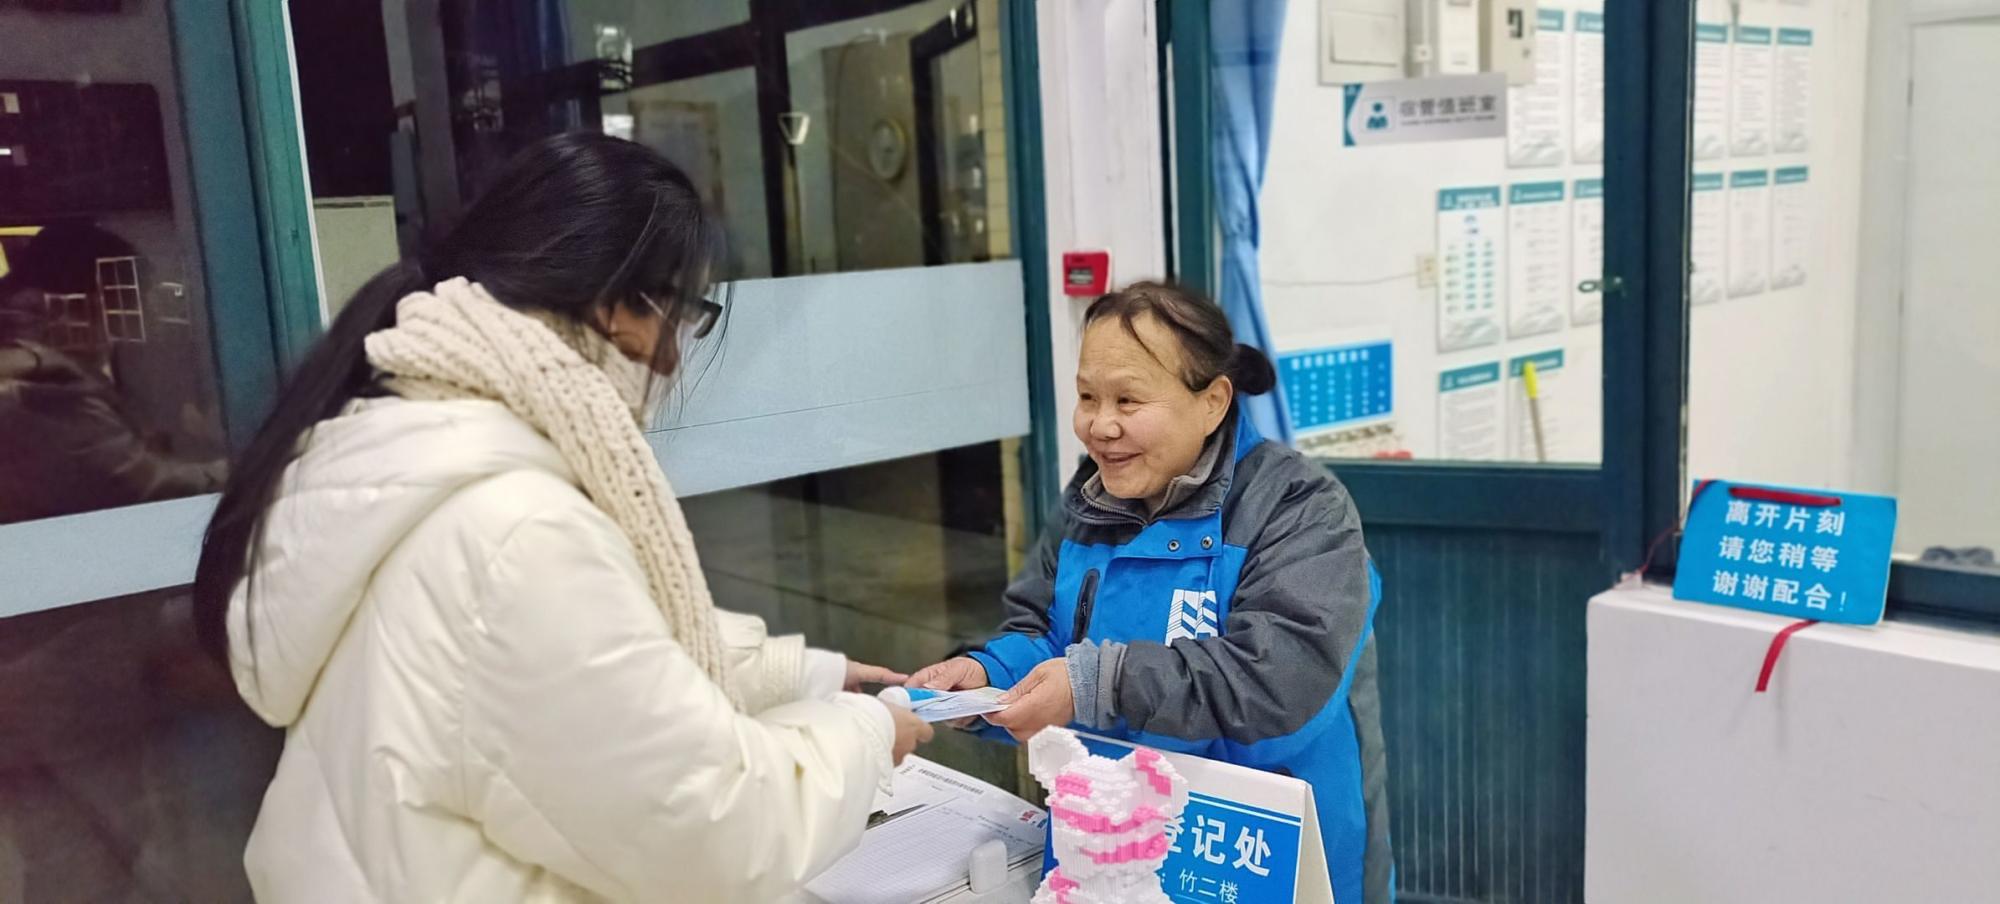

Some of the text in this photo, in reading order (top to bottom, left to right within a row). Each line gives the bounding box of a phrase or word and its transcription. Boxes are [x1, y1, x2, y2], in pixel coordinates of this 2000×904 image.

[1725, 499, 1846, 537] 离开片刻
[1719, 535, 1839, 573] 请您稍等
[1712, 569, 1847, 613] 谢谢配合！
